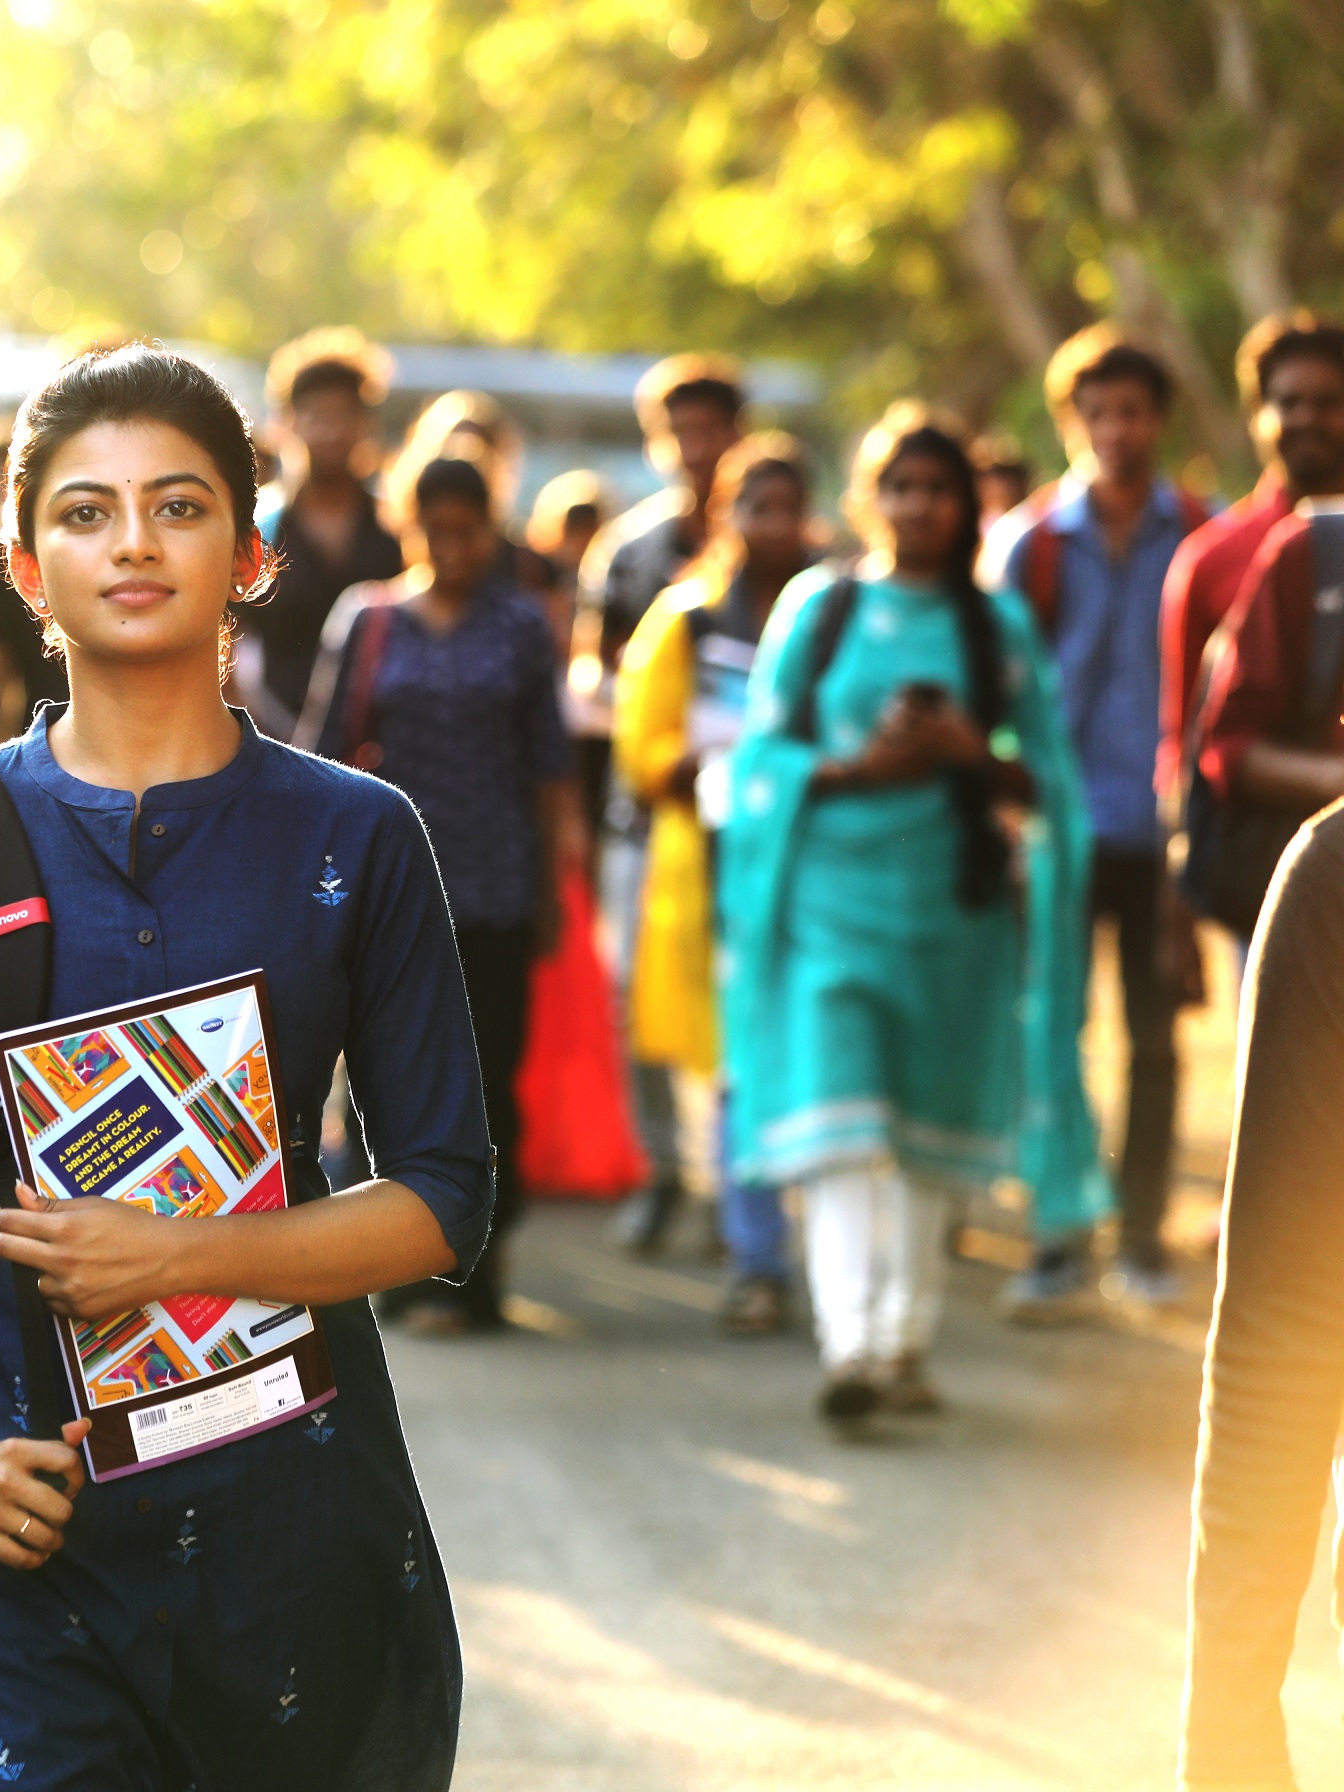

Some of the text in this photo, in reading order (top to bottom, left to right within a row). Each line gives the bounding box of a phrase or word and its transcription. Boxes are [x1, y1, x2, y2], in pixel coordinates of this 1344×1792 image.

[58, 1109, 123, 1163] A PENCIL ONCE
[64, 1105, 151, 1172] DREAMT IN COLOUR.
[74, 1126, 142, 1182] AND THE DREAM
[80, 1126, 162, 1192] BECAME A REALITY.
[185, 1305, 201, 1318] bring
[192, 1312, 206, 1326] Don't
[264, 1371, 289, 1387] Unruled
